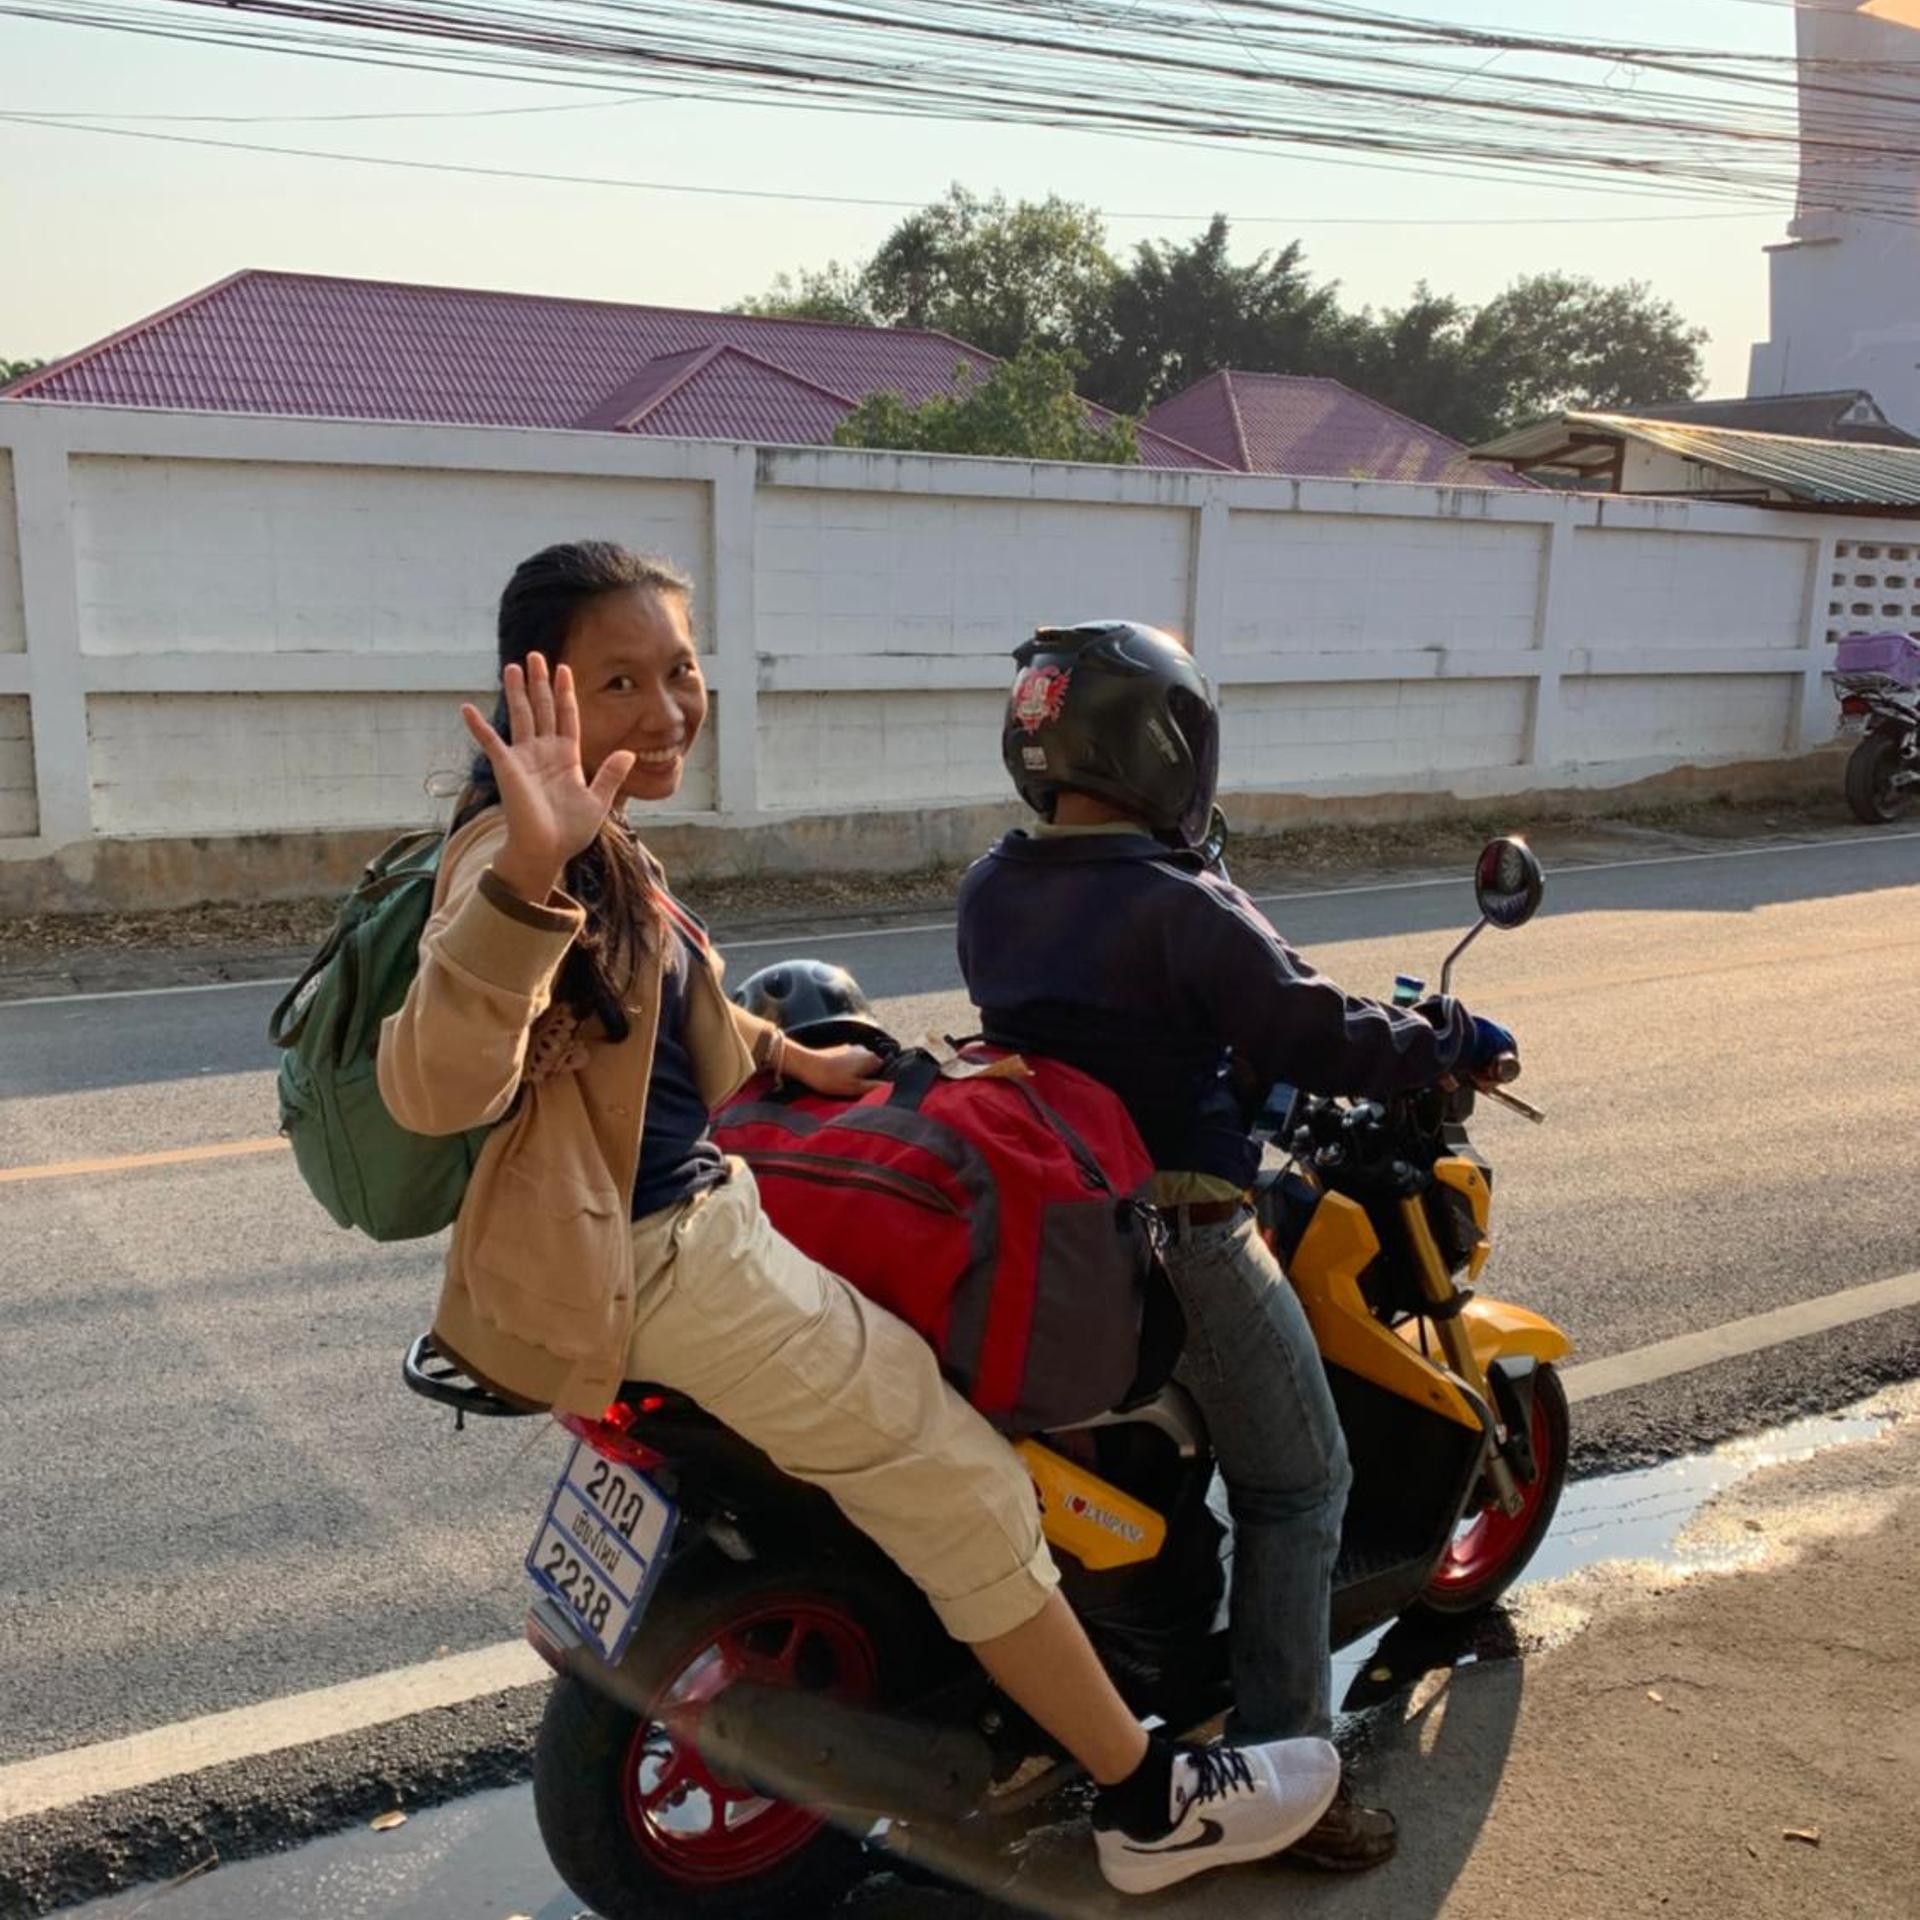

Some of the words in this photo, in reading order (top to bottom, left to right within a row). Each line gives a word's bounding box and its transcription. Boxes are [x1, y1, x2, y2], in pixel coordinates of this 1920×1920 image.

[572, 1509, 622, 1574] เชียงใหม่
[543, 1542, 611, 1636] 2238
